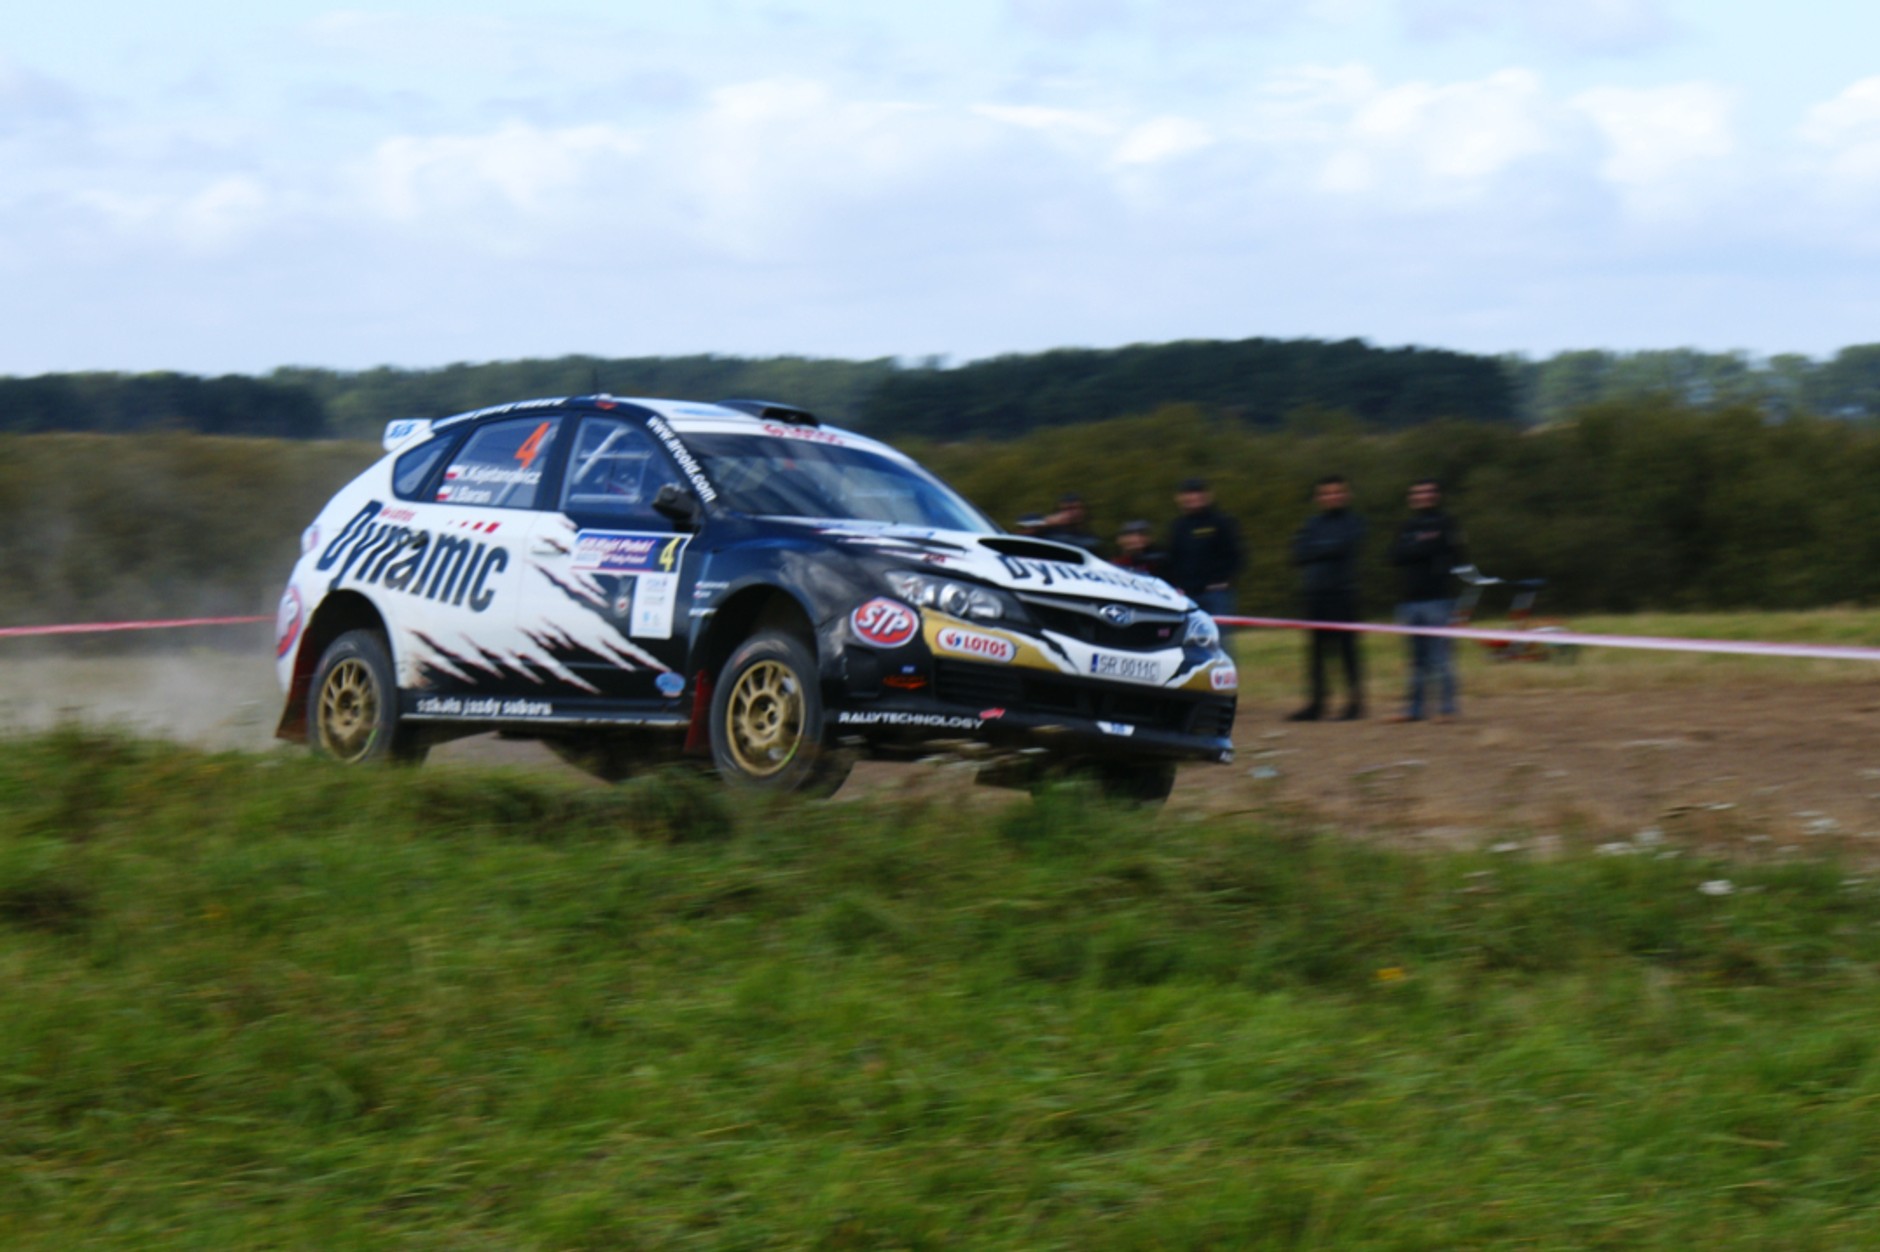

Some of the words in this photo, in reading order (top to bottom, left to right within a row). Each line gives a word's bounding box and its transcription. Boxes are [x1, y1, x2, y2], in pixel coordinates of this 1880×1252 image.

[514, 421, 551, 469] 4
[316, 499, 510, 613] Dynamic
[658, 536, 681, 572] 4
[857, 604, 910, 636] STP
[963, 635, 1008, 659] LOTOS
